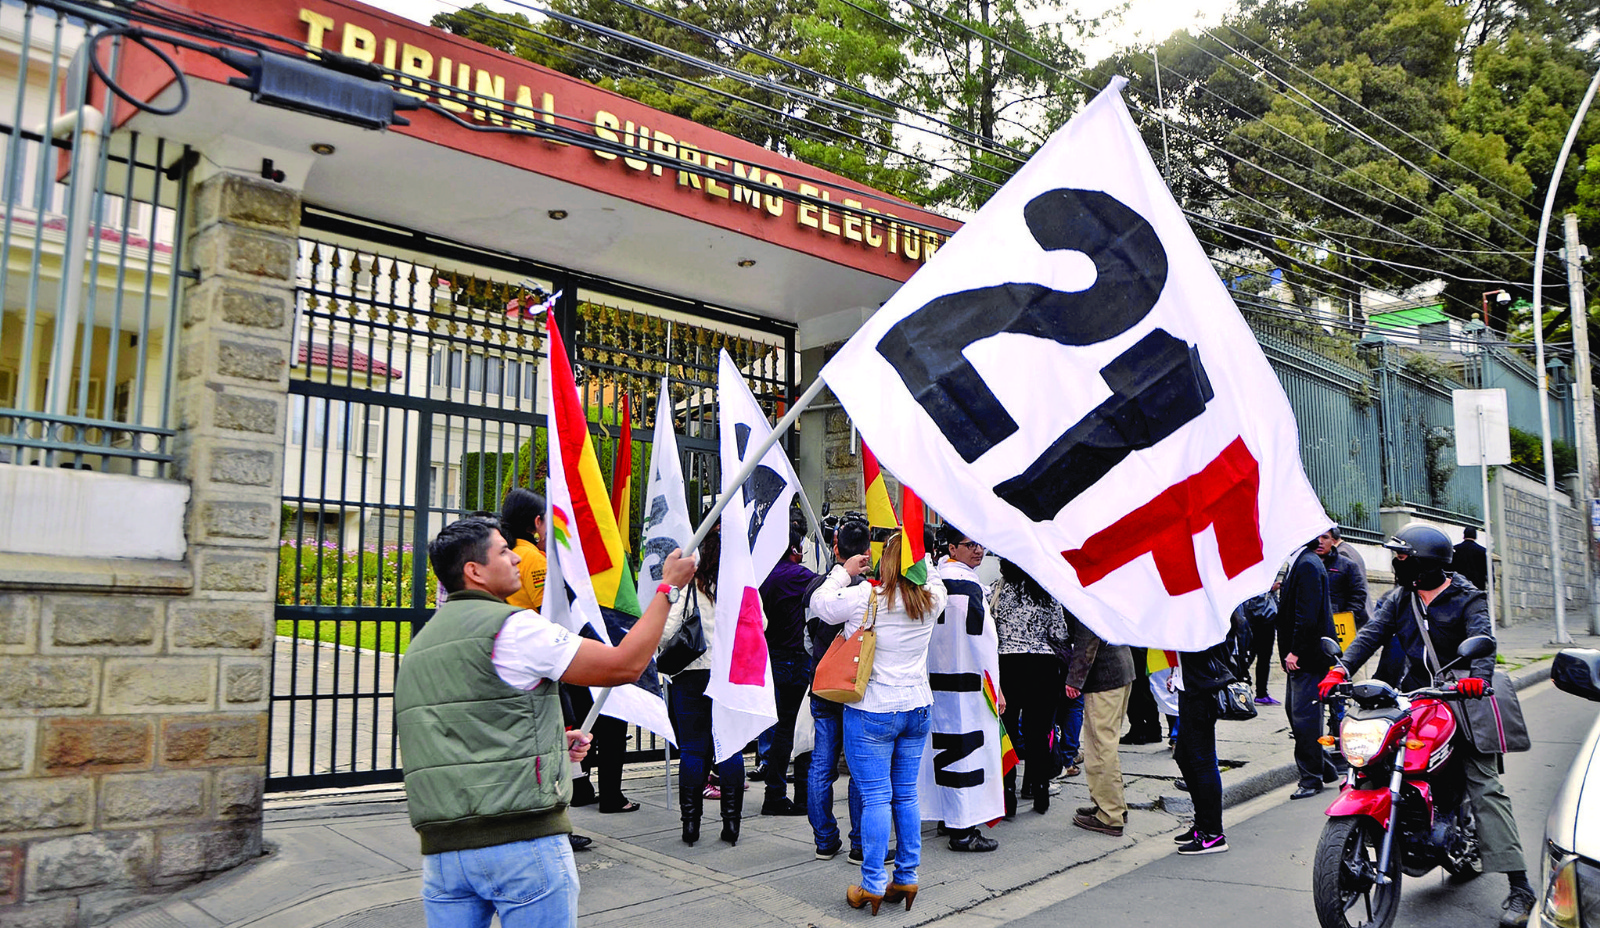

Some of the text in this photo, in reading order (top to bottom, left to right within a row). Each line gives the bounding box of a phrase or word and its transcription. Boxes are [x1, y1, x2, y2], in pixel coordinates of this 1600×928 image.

[299, 8, 951, 263] TRIBUNAL SUPREMO ELECTOR
[875, 187, 1264, 596] 21F
